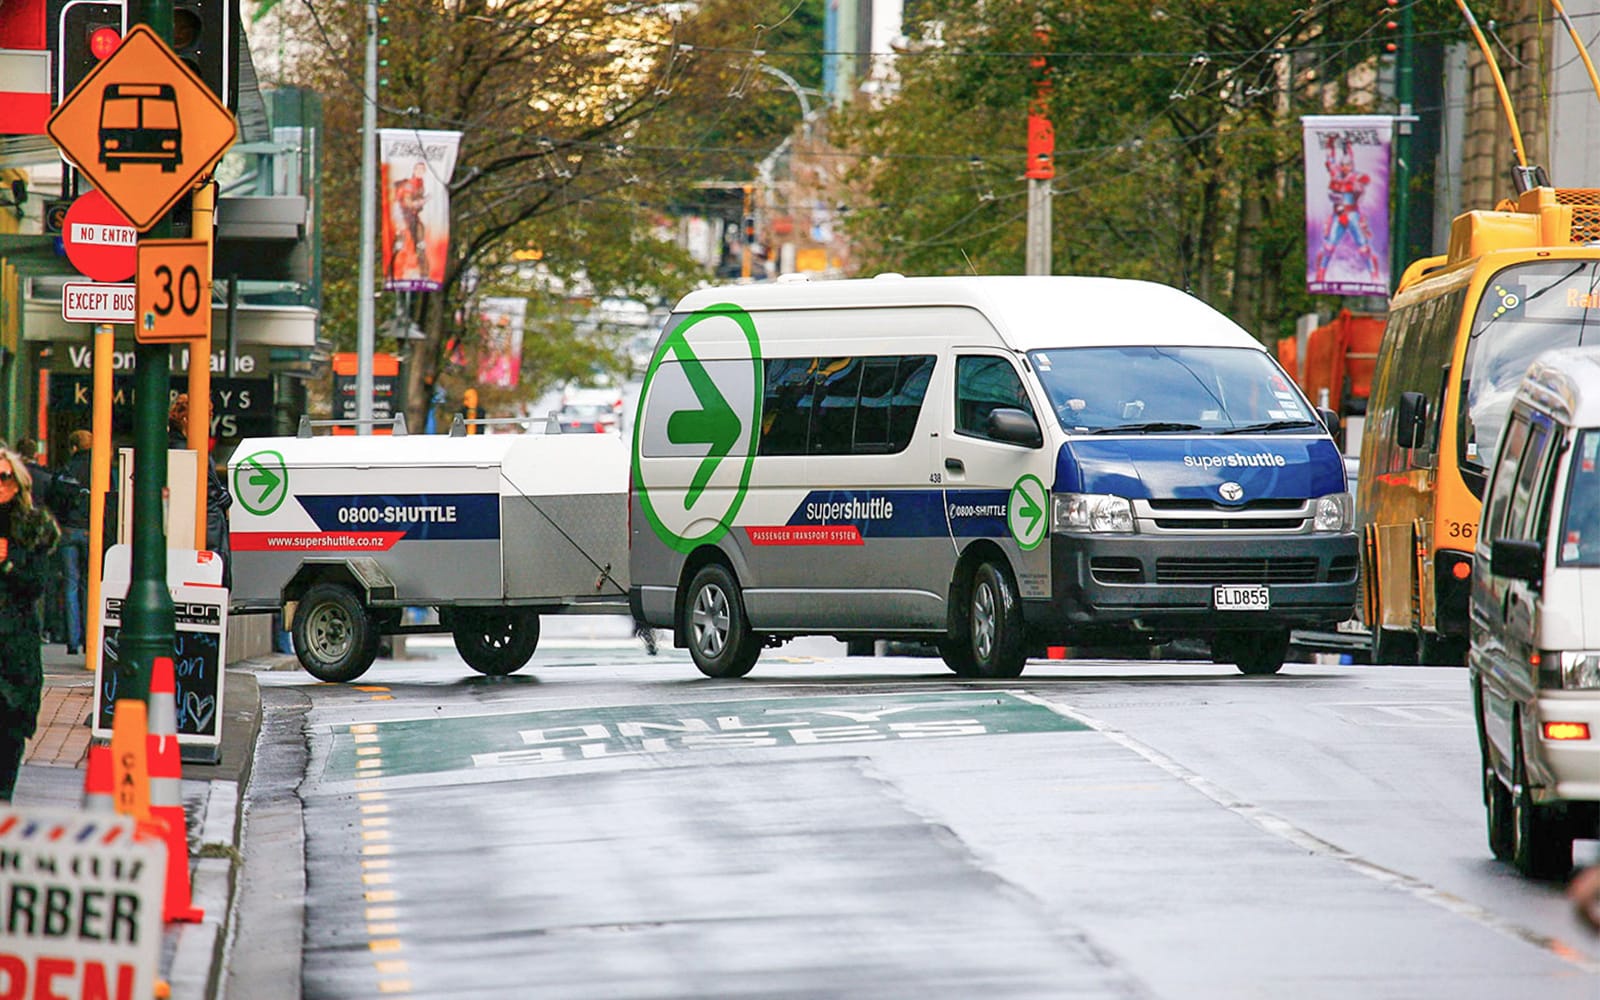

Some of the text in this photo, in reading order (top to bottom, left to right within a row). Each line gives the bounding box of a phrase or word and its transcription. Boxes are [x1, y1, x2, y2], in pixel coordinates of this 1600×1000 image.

[81, 227, 134, 243] NO ENTRY
[154, 265, 200, 316] 30
[1567, 287, 1600, 309] Rai
[69, 292, 136, 311] EXCEPT BUS
[1184, 453, 1286, 470] supershuttle
[338, 506, 457, 524] 0800-SHUTTLE
[806, 497, 893, 525] supershuttle
[955, 505, 1006, 517] 0800-SHUTTLE
[267, 535, 384, 548] www.supershuttle.co.nz
[753, 531, 857, 541] PASSENGER TRANSPORT SYSTEM
[1216, 590, 1268, 605] ELD855
[518, 706, 918, 746] ONLY
[472, 719, 987, 768] BUSES
[0, 883, 141, 944] RBER
